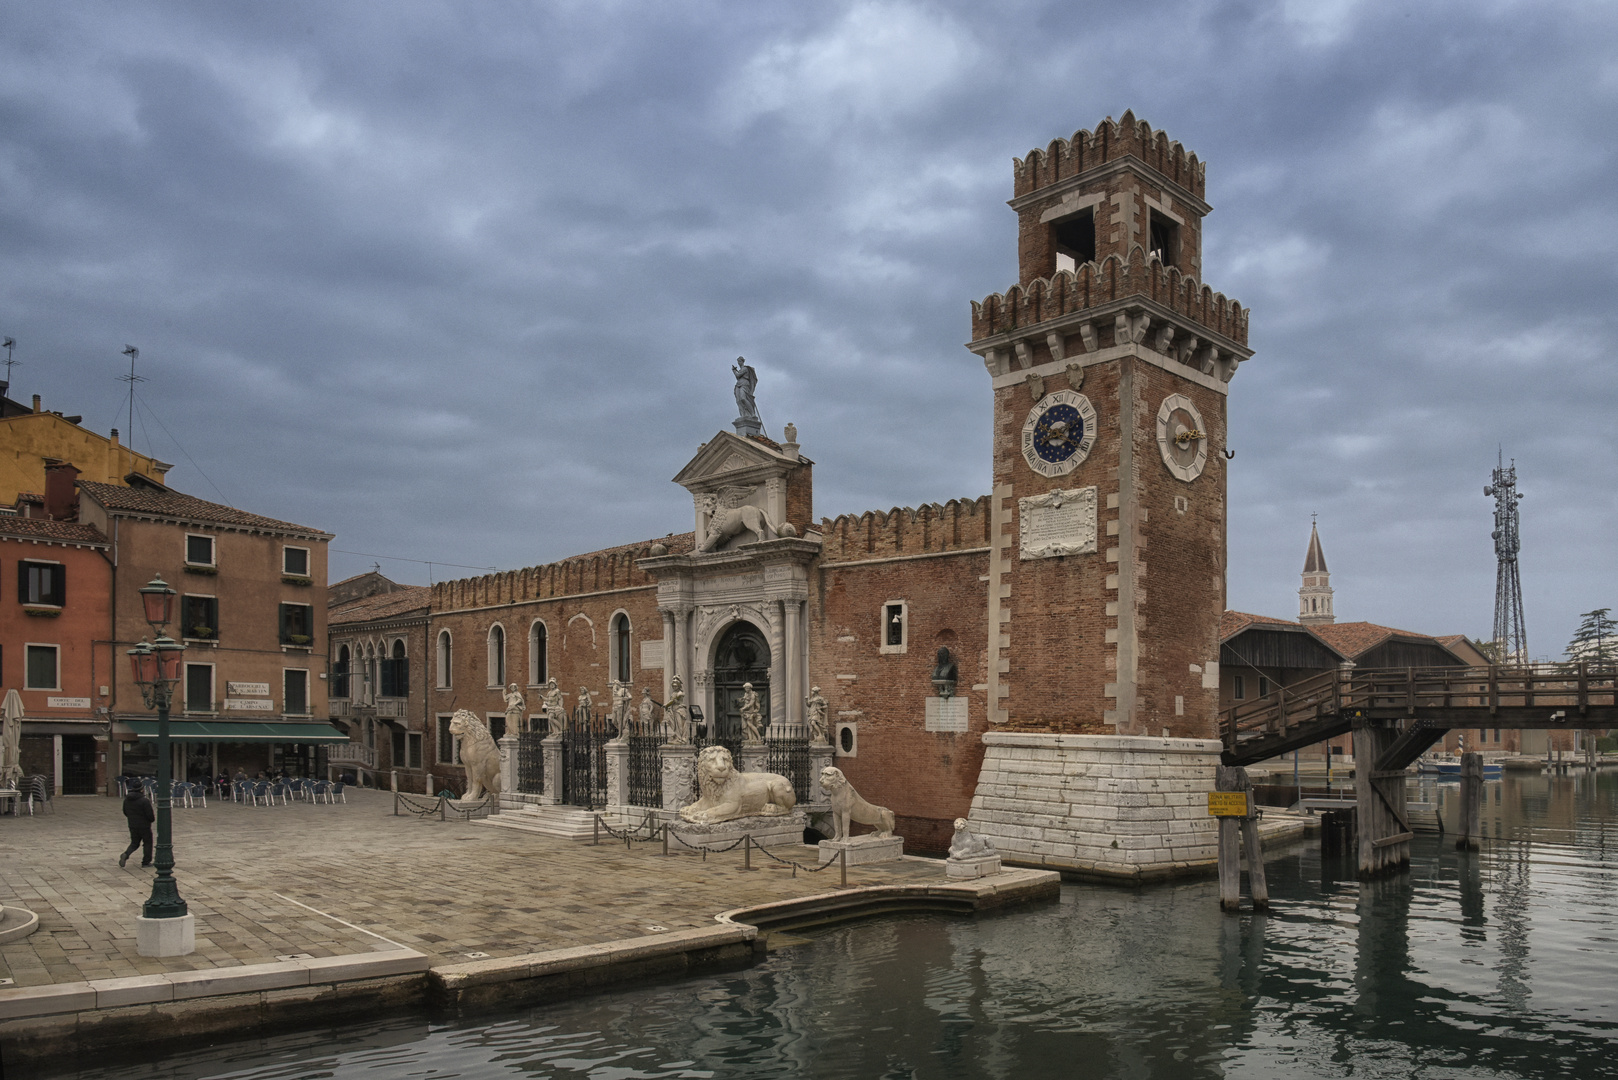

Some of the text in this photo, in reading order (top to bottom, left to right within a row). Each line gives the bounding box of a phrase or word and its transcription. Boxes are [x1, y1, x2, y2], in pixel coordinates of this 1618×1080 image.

[1053, 394, 1064, 403] XII
[1039, 401, 1048, 412] XI
[1028, 417, 1036, 426] X
[1086, 422, 1094, 432] III
[1071, 458, 1078, 467] V
[1054, 466, 1063, 474] VI
